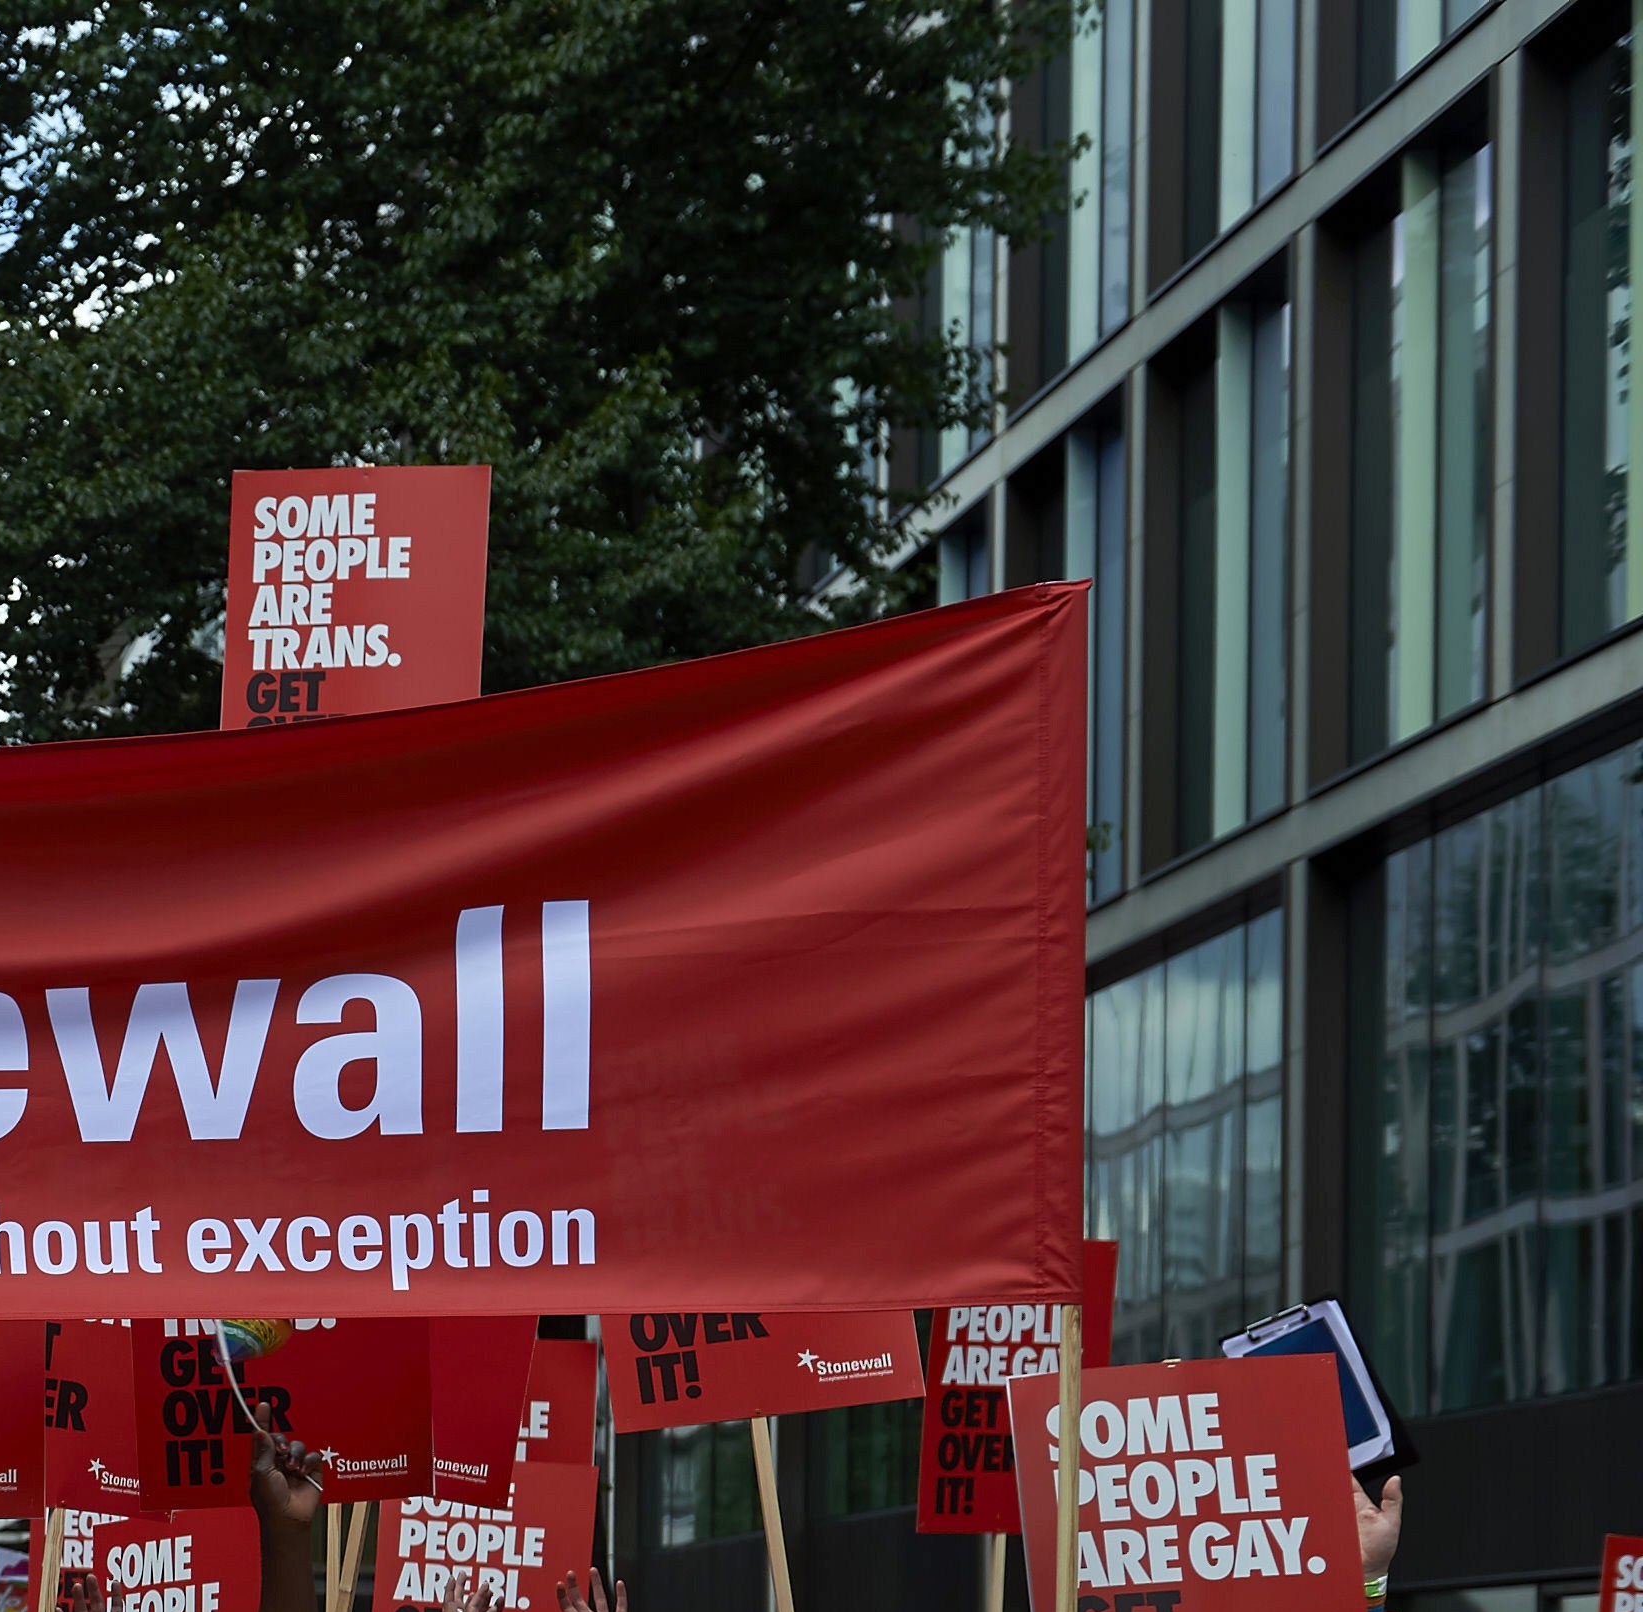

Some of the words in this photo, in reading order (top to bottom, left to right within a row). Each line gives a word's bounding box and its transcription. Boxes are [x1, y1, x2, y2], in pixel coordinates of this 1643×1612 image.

[254, 493, 376, 539] SOME
[253, 536, 411, 582] PEOPLE
[248, 583, 333, 626] ARE
[248, 624, 401, 670] TRANS.
[246, 671, 326, 714] GET
[201, 1189, 597, 1291] exception
[636, 1350, 702, 1405] IT!
[817, 1352, 892, 1375] Stonewall
[940, 1390, 1000, 1429] GET
[166, 1440, 226, 1486] IT!
[336, 1453, 408, 1473] Stonewall
[936, 1478, 974, 1515] IT!
[399, 1520, 546, 1568] PEOPLE
[1189, 1517, 1326, 1580] GAY.
